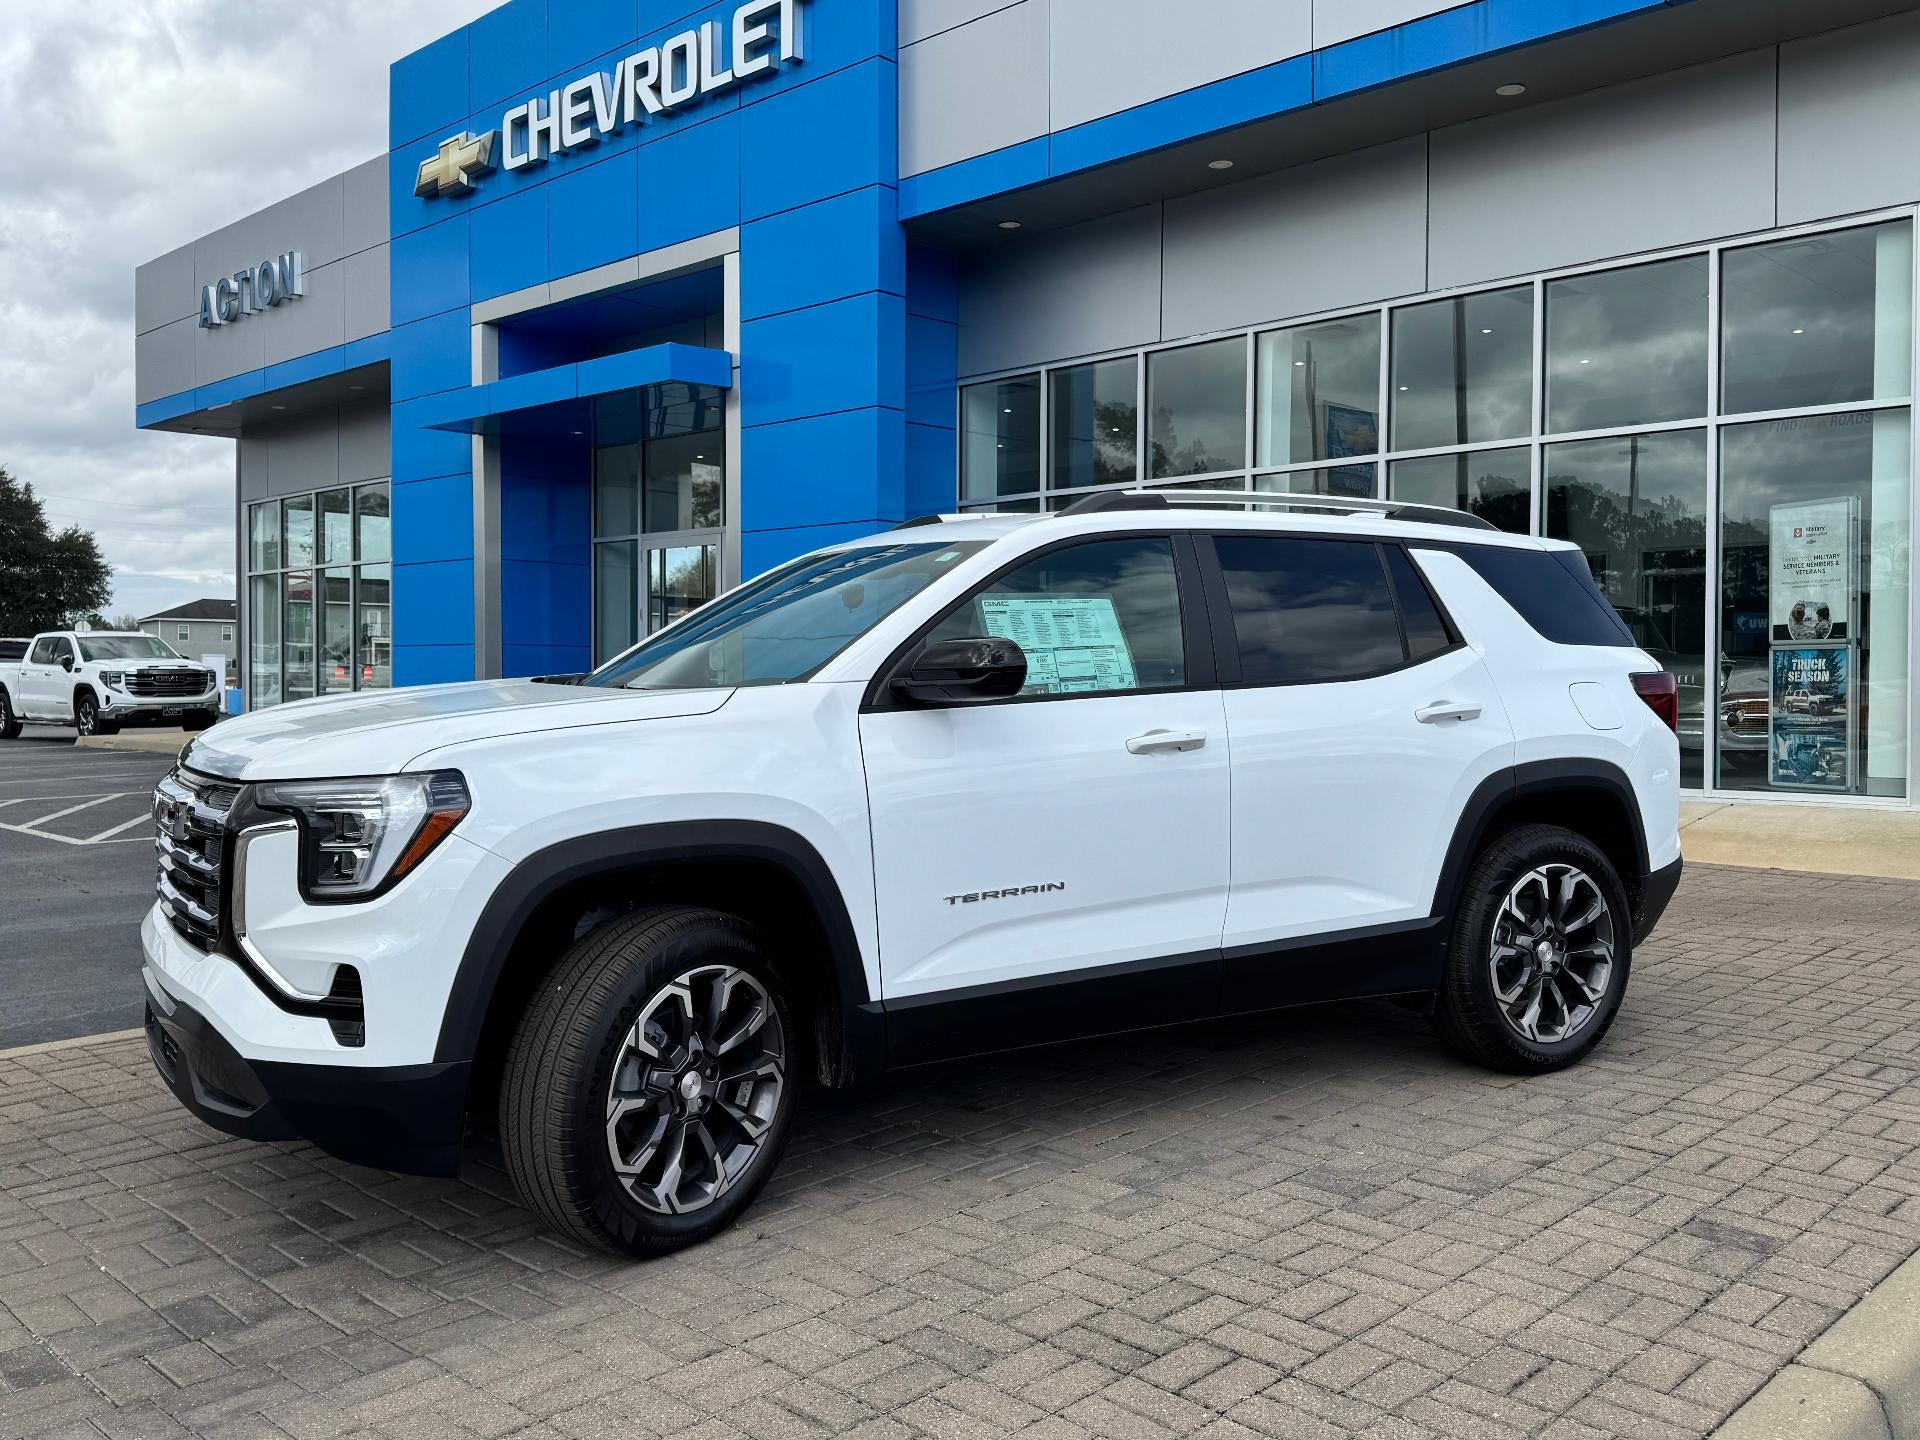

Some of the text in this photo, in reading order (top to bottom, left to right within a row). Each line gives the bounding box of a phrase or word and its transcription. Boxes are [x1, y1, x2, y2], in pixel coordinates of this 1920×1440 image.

[199, 251, 302, 329] ACTION
[1830, 412, 1873, 428] ROADS
[1813, 553, 1841, 561] MILITARY
[1783, 562, 1805, 570] SERVICE
[1791, 658, 1827, 671] TRUCK
[1787, 670, 1830, 682] SEASON
[943, 881, 1065, 905] TERRAIN
